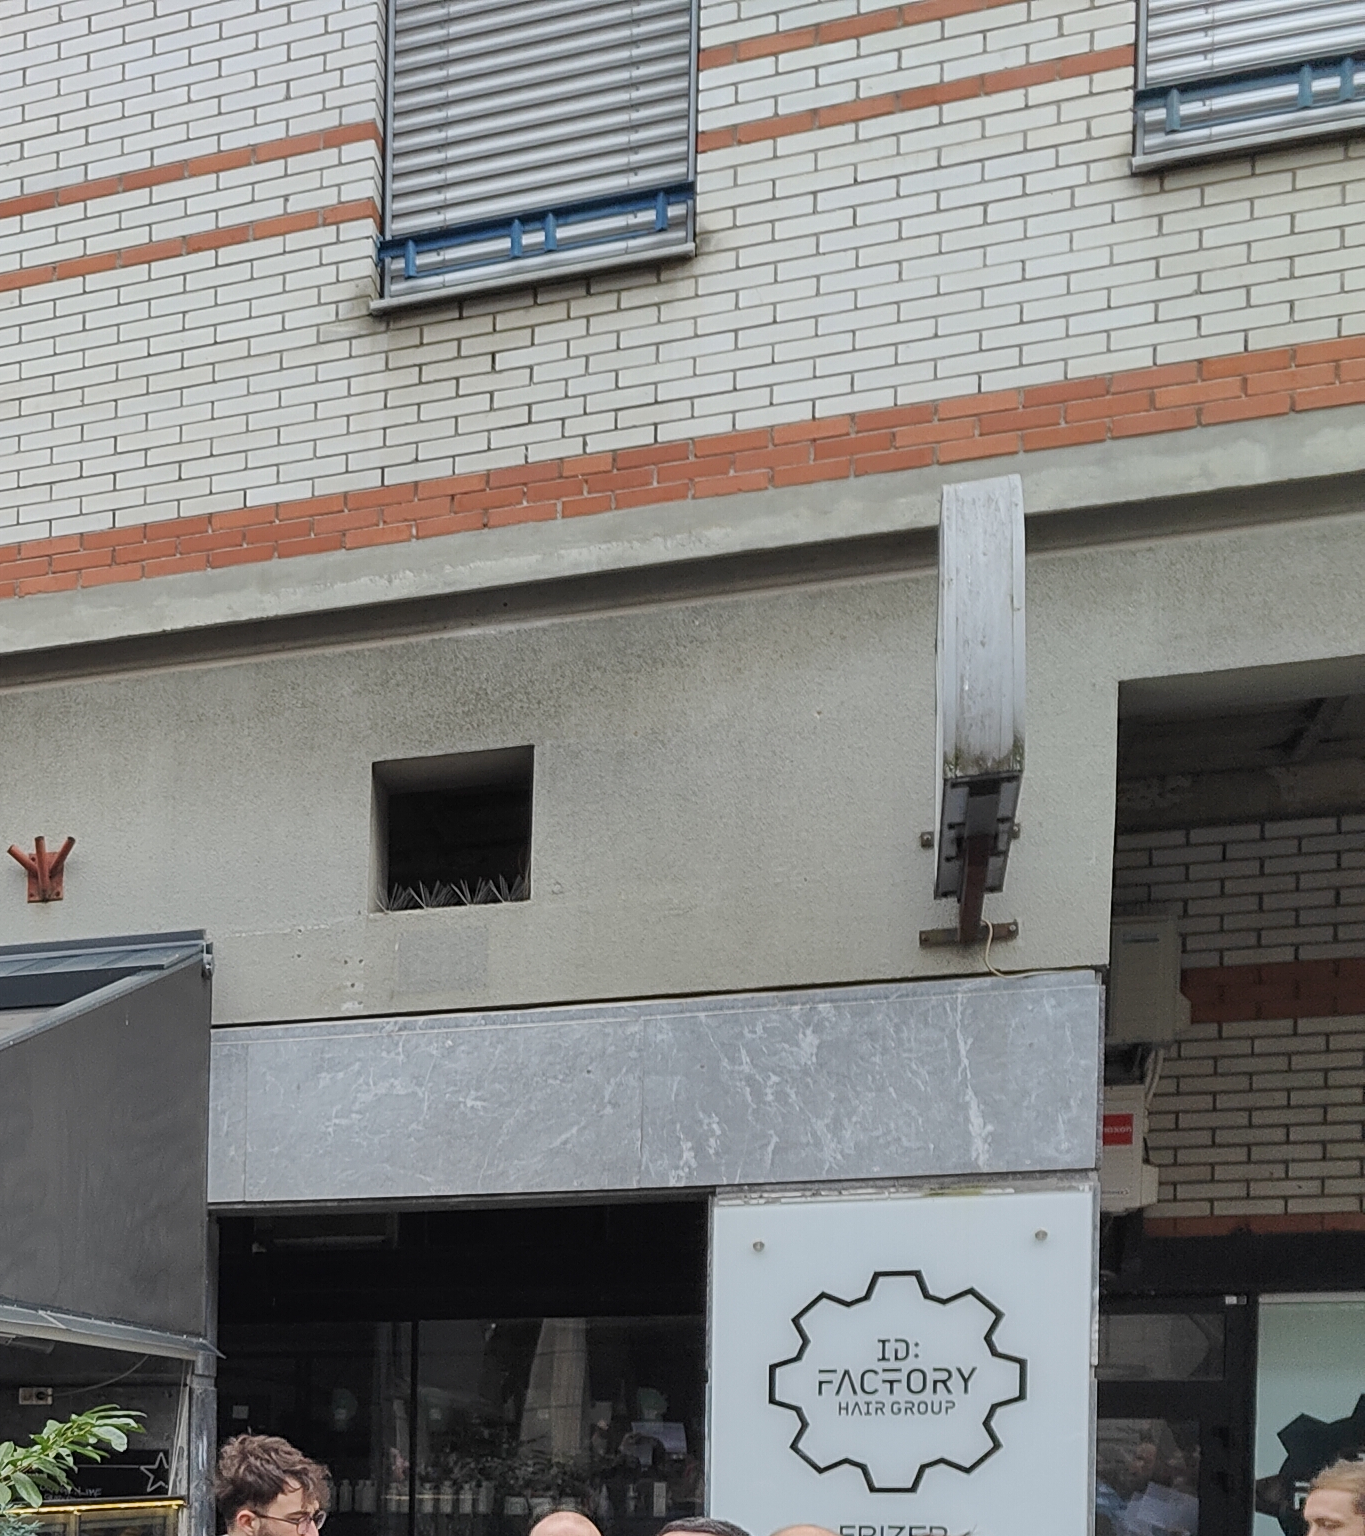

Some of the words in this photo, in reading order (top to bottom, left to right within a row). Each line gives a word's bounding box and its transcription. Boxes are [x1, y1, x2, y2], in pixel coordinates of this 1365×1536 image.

[877, 1338, 920, 1362] ID:
[818, 1366, 978, 1396] FACTORY
[838, 1401, 886, 1416] HAIR
[890, 1400, 956, 1415] GROUP
